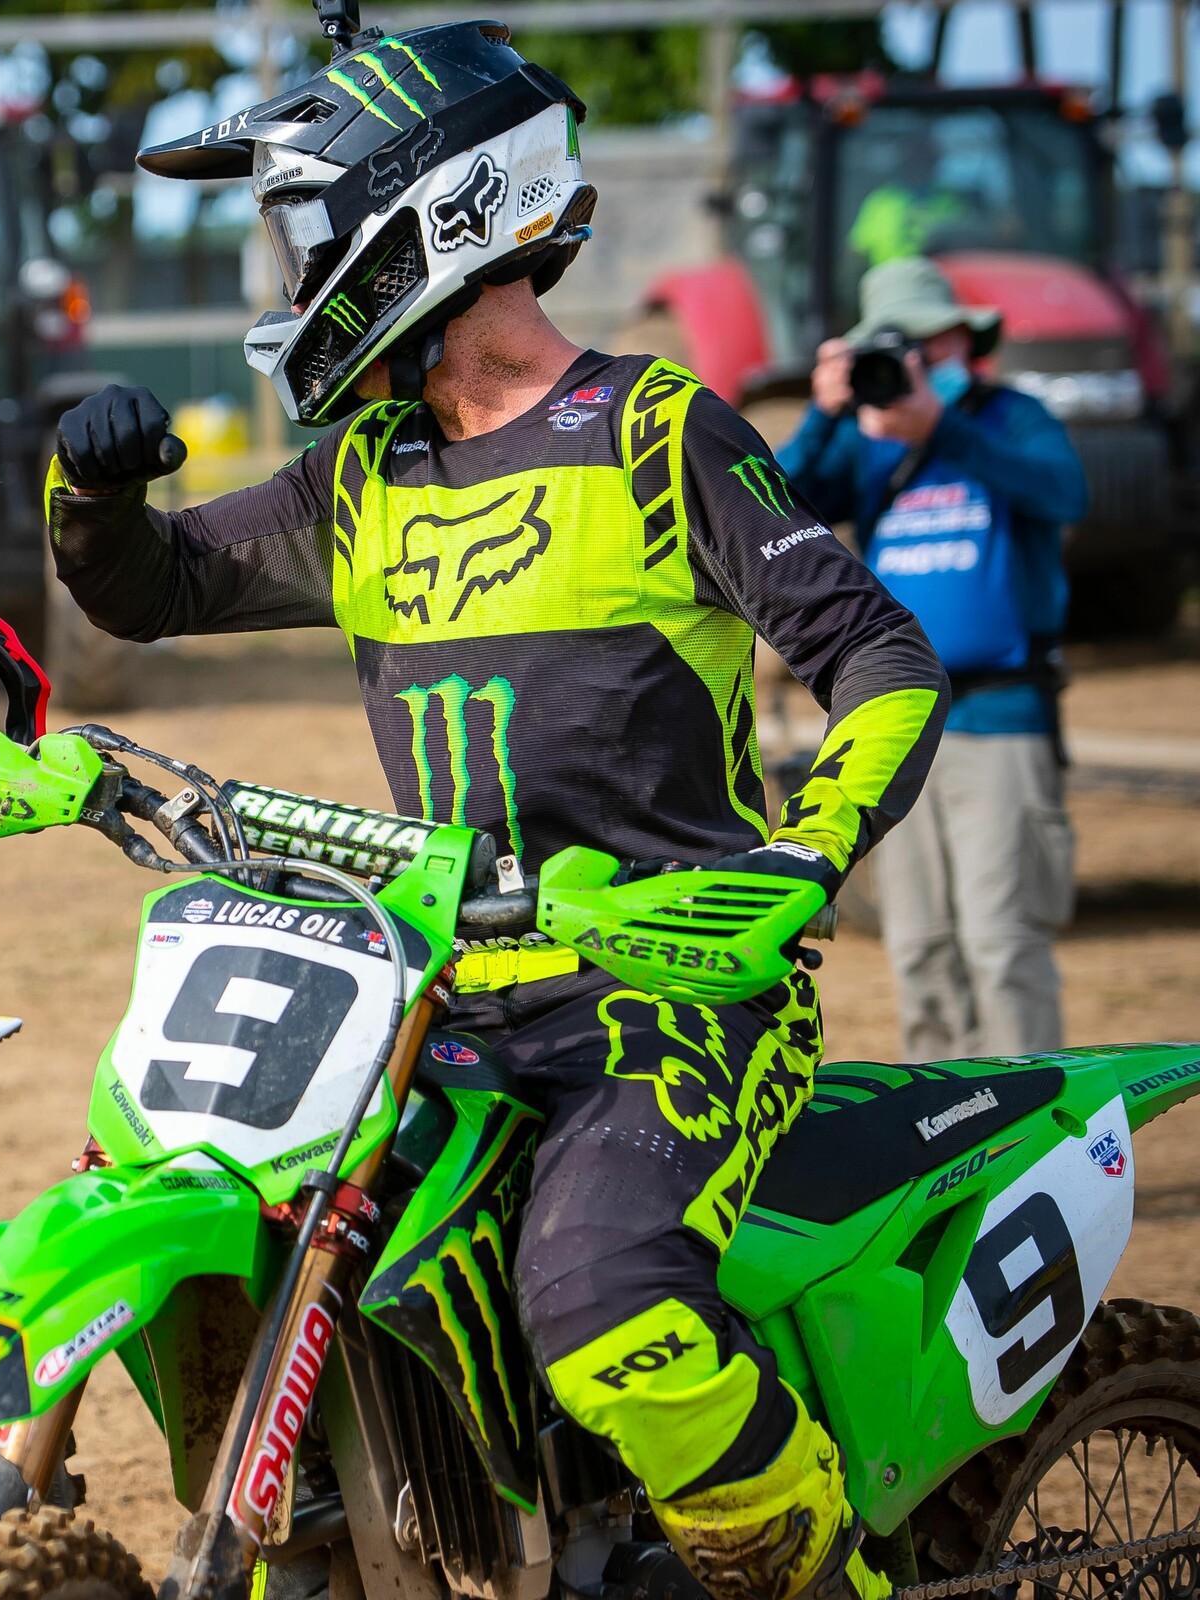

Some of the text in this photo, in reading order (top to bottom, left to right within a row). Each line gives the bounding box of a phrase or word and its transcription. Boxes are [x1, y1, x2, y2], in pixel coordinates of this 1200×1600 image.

[201, 112, 249, 145] FOX
[560, 414, 579, 425] FIM
[759, 522, 834, 561] Kawasak
[230, 790, 429, 852] RENTHA
[213, 901, 348, 944] LUCAS OIL
[573, 927, 743, 974] ACERBIS
[140, 944, 360, 1131] 9
[1125, 1060, 1200, 1097] DUNLO
[108, 1081, 154, 1148] Kawasaki
[915, 1087, 999, 1142] Kawasaki
[1089, 1132, 1117, 1160] MX
[926, 1147, 988, 1201] 450
[962, 1192, 1086, 1395] 9
[591, 1330, 697, 1391] FOX
[247, 1304, 334, 1522] SHOWA
